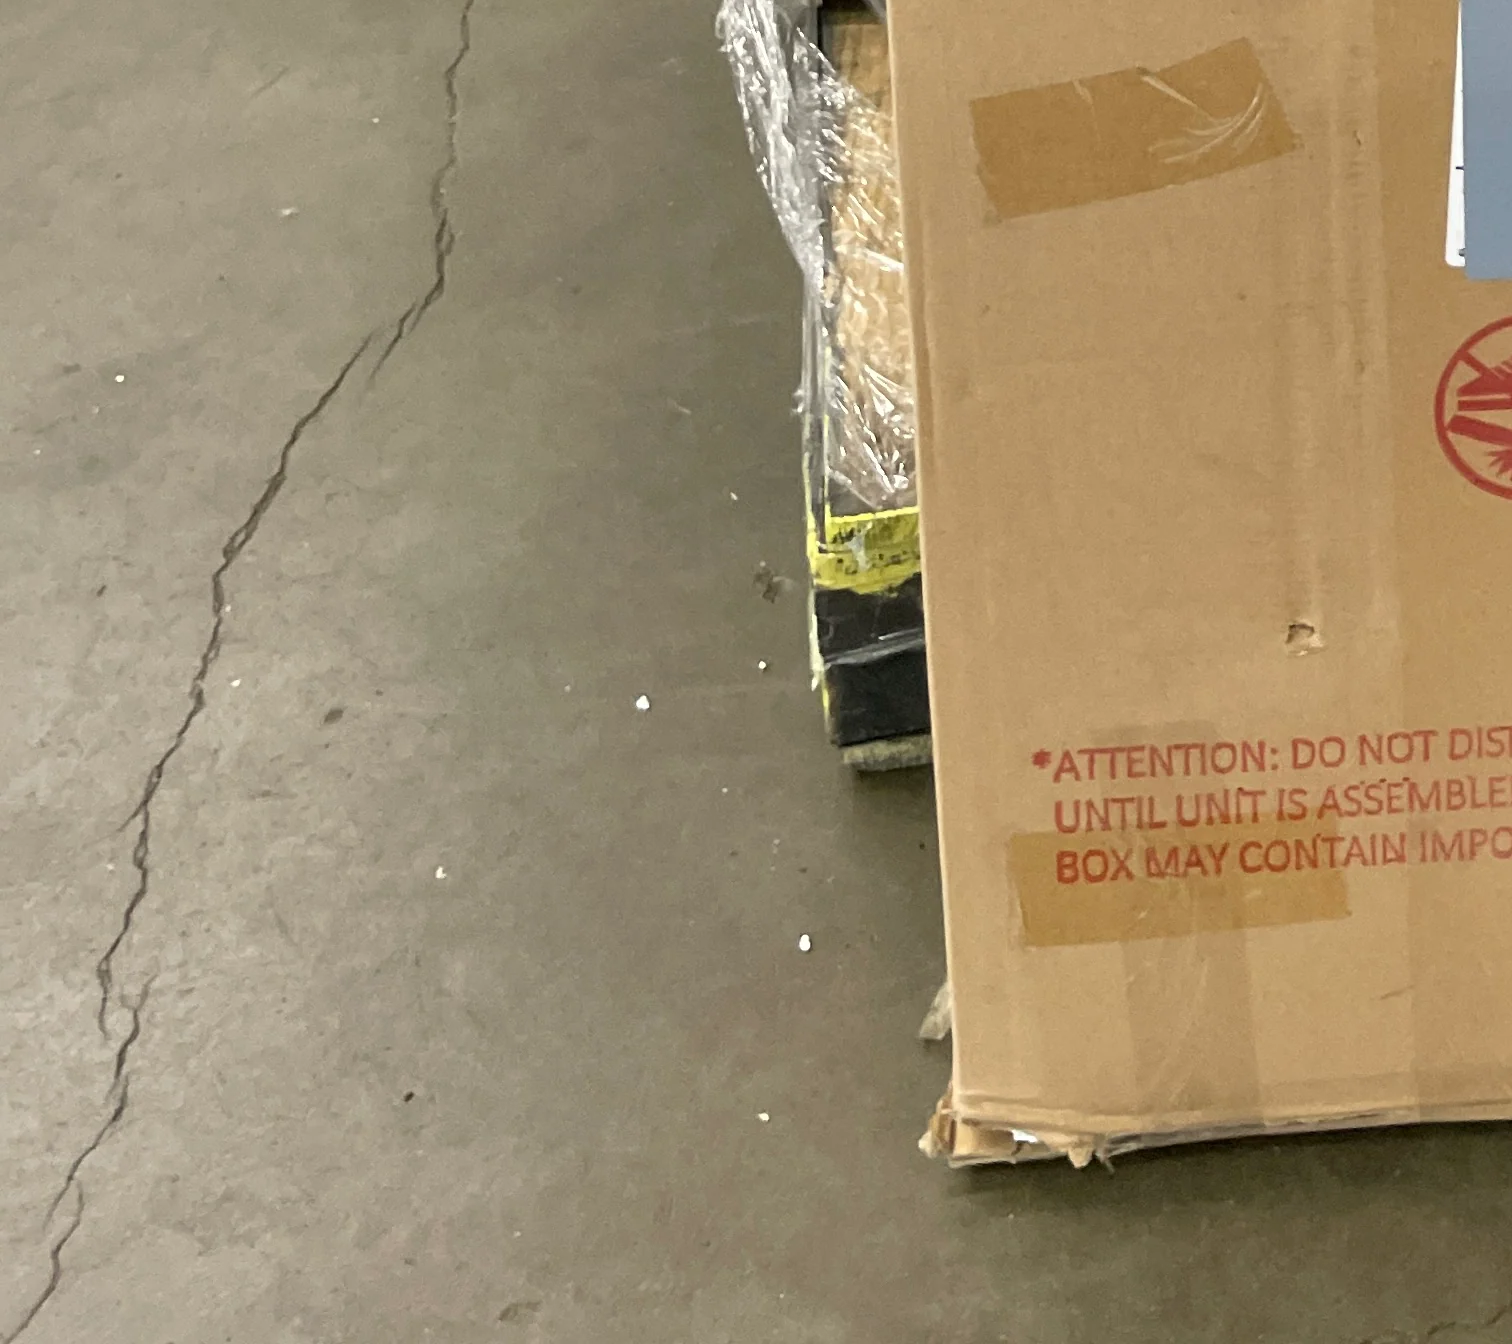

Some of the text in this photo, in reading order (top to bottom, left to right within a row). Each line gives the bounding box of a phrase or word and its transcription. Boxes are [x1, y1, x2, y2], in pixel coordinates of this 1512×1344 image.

[1291, 735, 1346, 771] DO
[1357, 729, 1438, 767] NOT
[1054, 796, 1167, 834] UNTIL
[1176, 786, 1266, 830] UNIT
[1276, 786, 1308, 823] IS
[1056, 848, 1134, 885] BOX
[1145, 841, 1229, 879] MAY
[1239, 831, 1407, 874] CONTAIN
